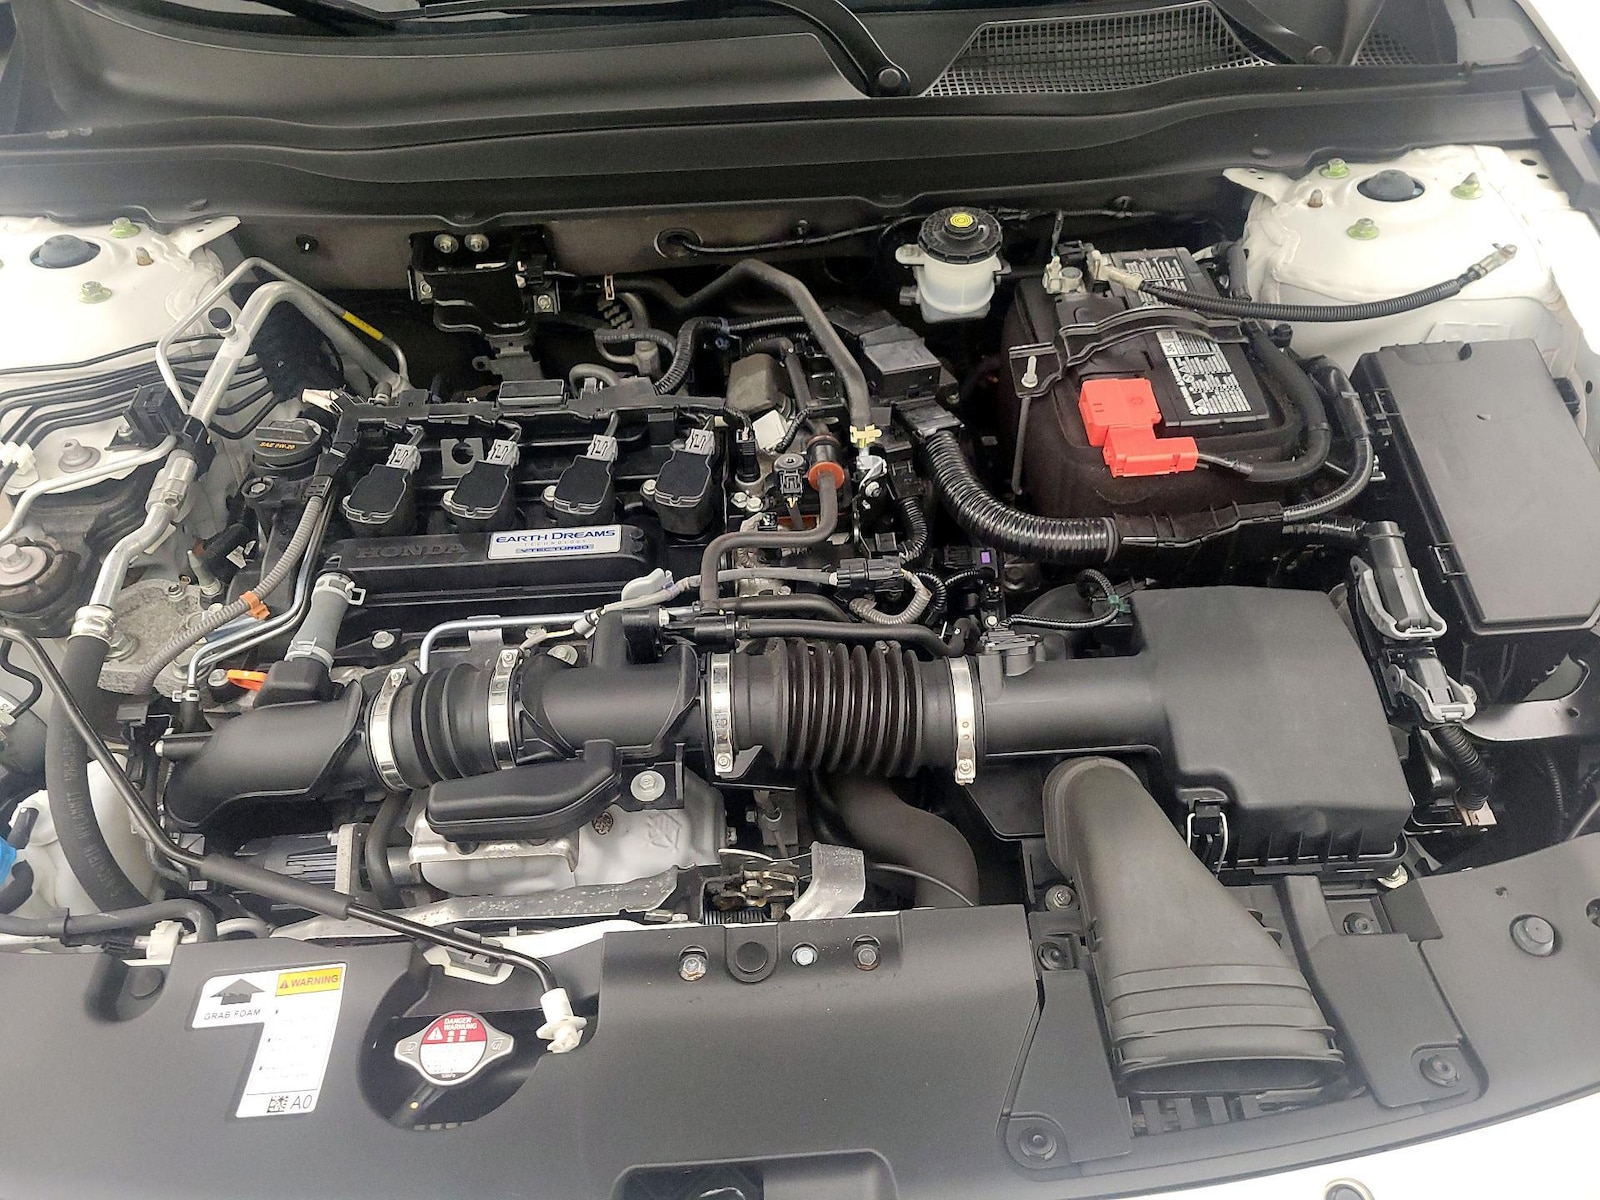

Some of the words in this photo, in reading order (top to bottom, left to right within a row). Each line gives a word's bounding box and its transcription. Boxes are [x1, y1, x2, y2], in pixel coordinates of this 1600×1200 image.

[496, 533, 548, 543] EARTH
[552, 529, 616, 540] DREAMS
[356, 543, 468, 559] HONDA
[290, 974, 340, 988] WARNING
[204, 1011, 231, 1021] GRAB
[233, 1008, 262, 1018] FOAM
[444, 1017, 473, 1025] DANGER
